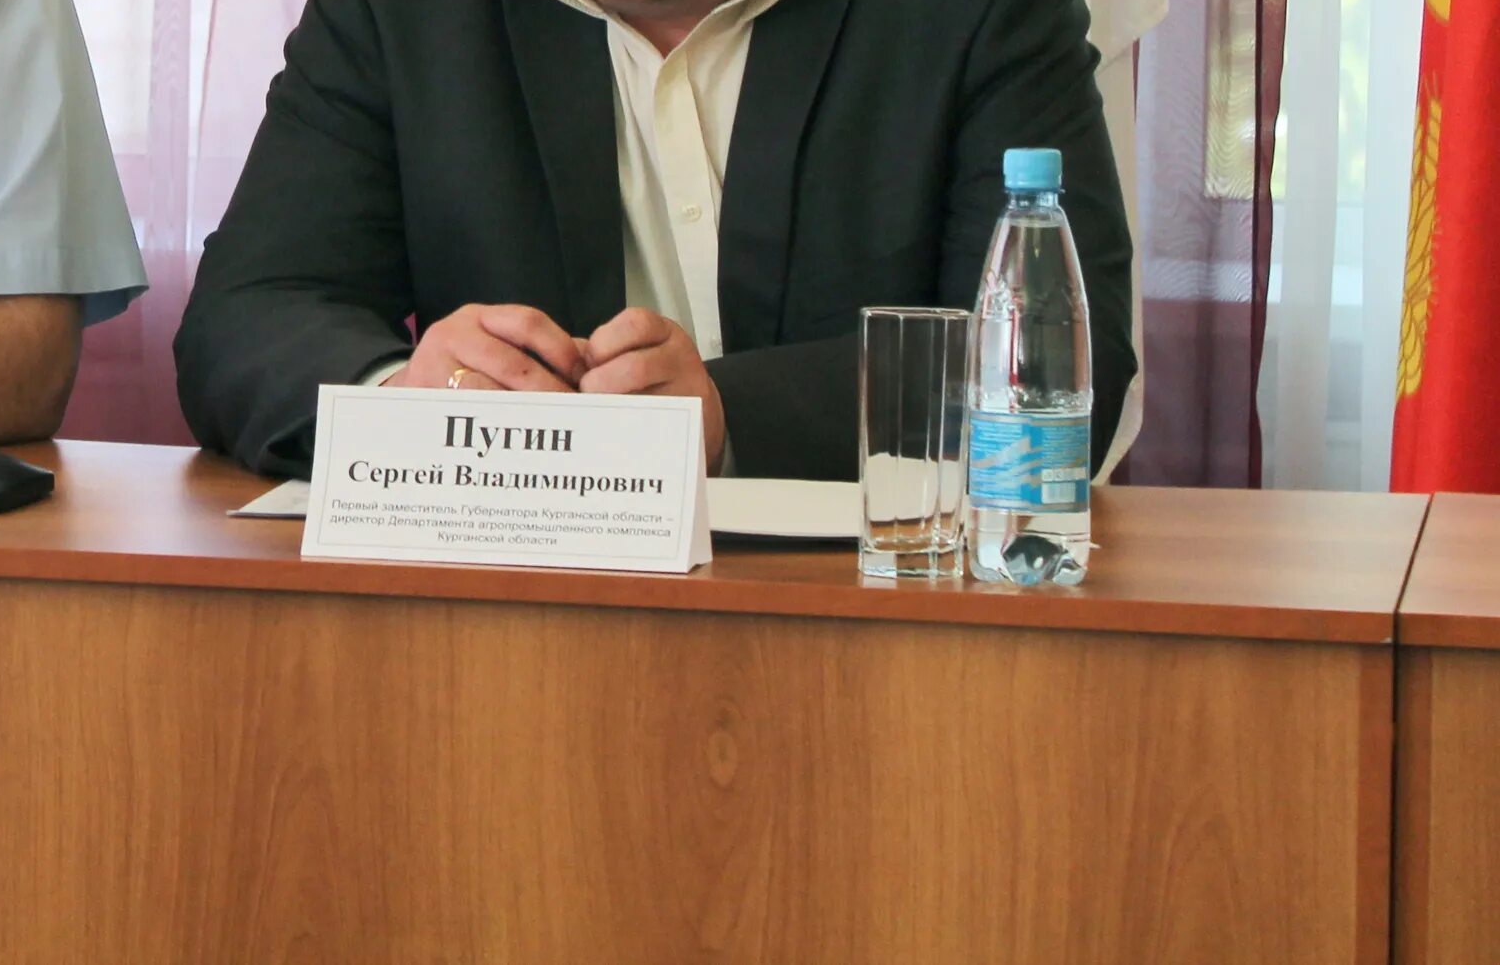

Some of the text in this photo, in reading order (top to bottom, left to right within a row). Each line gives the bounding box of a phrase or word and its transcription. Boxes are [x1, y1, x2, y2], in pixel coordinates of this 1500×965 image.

[443, 415, 575, 457] Пугин
[348, 460, 665, 496] Сергей Владимирович
[331, 499, 378, 512] Первый
[381, 502, 457, 515] заместитель
[460, 504, 538, 519] Губернатора
[541, 508, 609, 522] Курганской
[612, 511, 662, 523] области
[329, 514, 671, 538] директор Департамента агропромышленного комплекса
[437, 531, 558, 546] Курганской области
